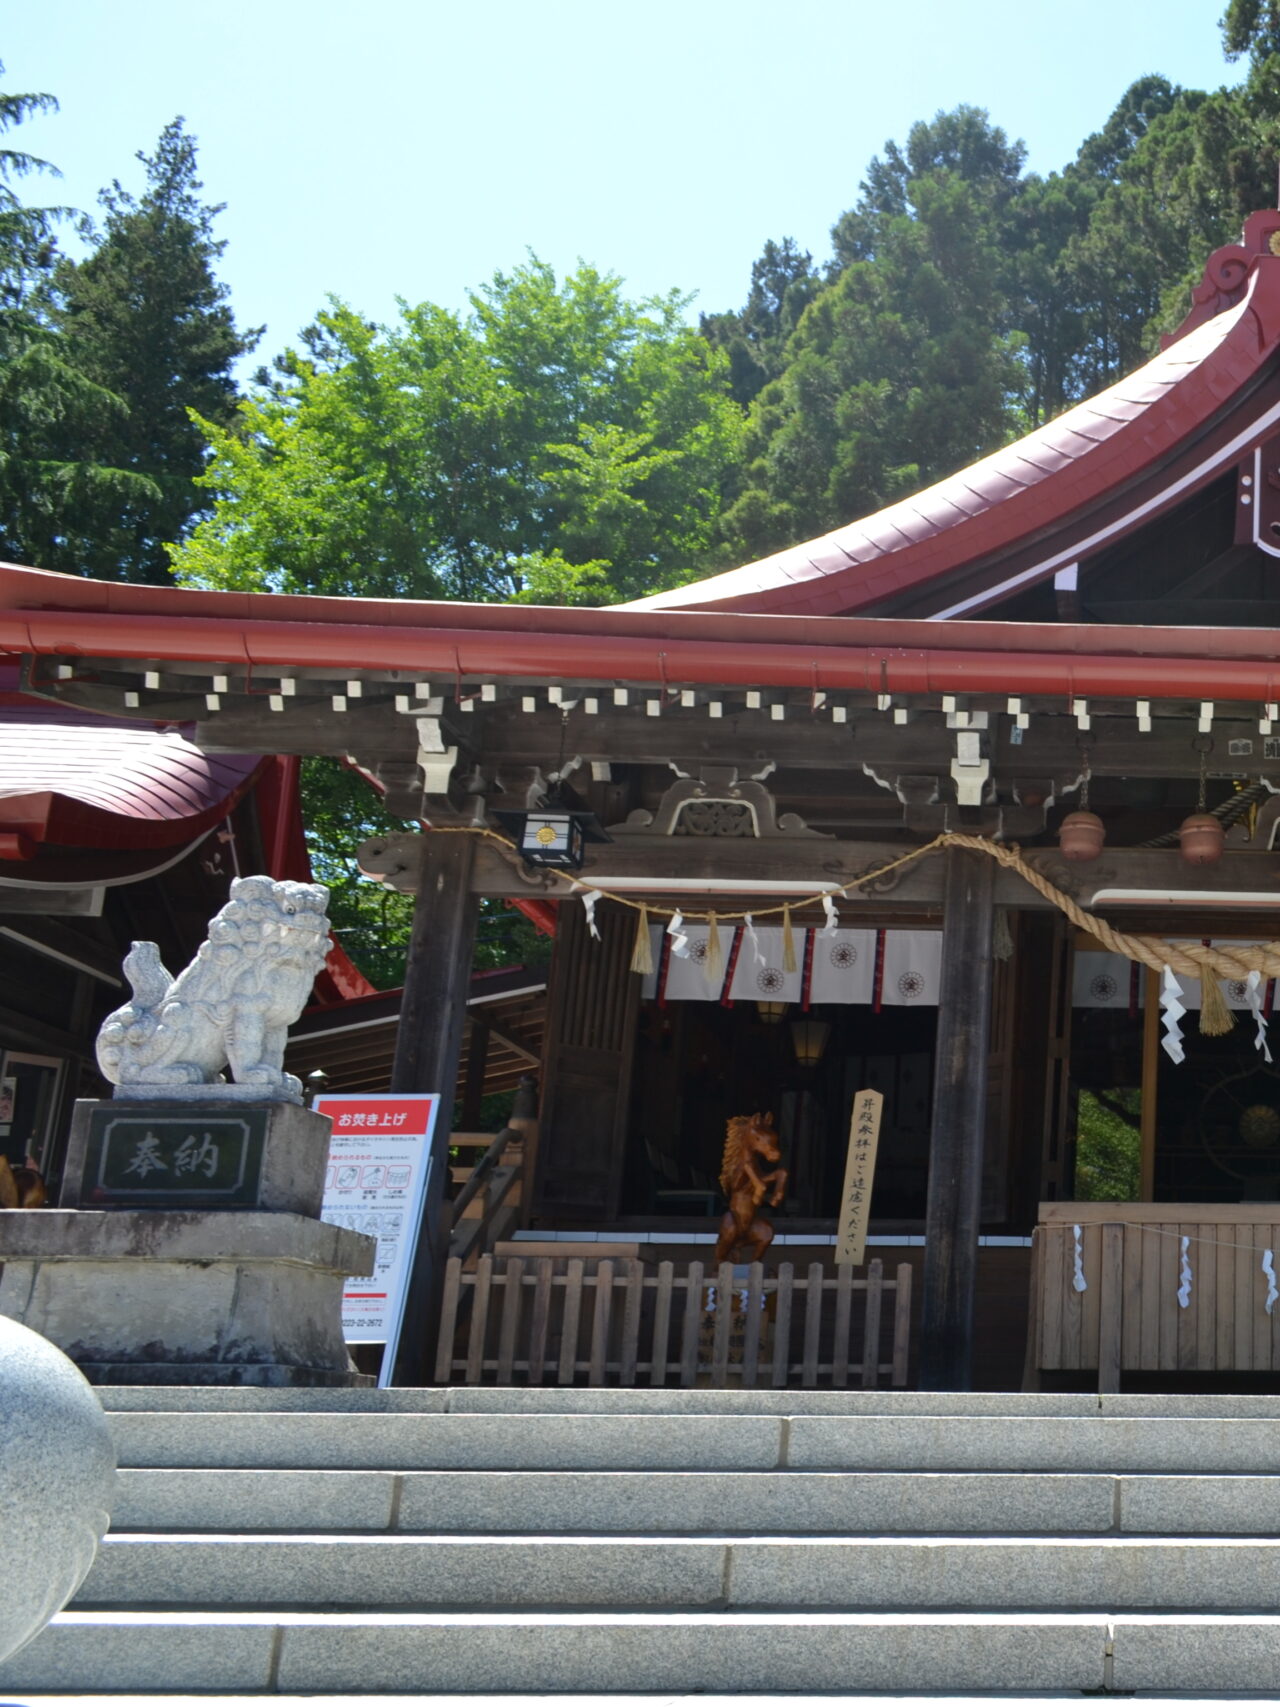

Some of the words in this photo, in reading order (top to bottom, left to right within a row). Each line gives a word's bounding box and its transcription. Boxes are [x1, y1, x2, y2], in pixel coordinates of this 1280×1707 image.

[338, 1112, 408, 1127] お焚き上げ
[122, 1130, 220, 1178] 奉納
